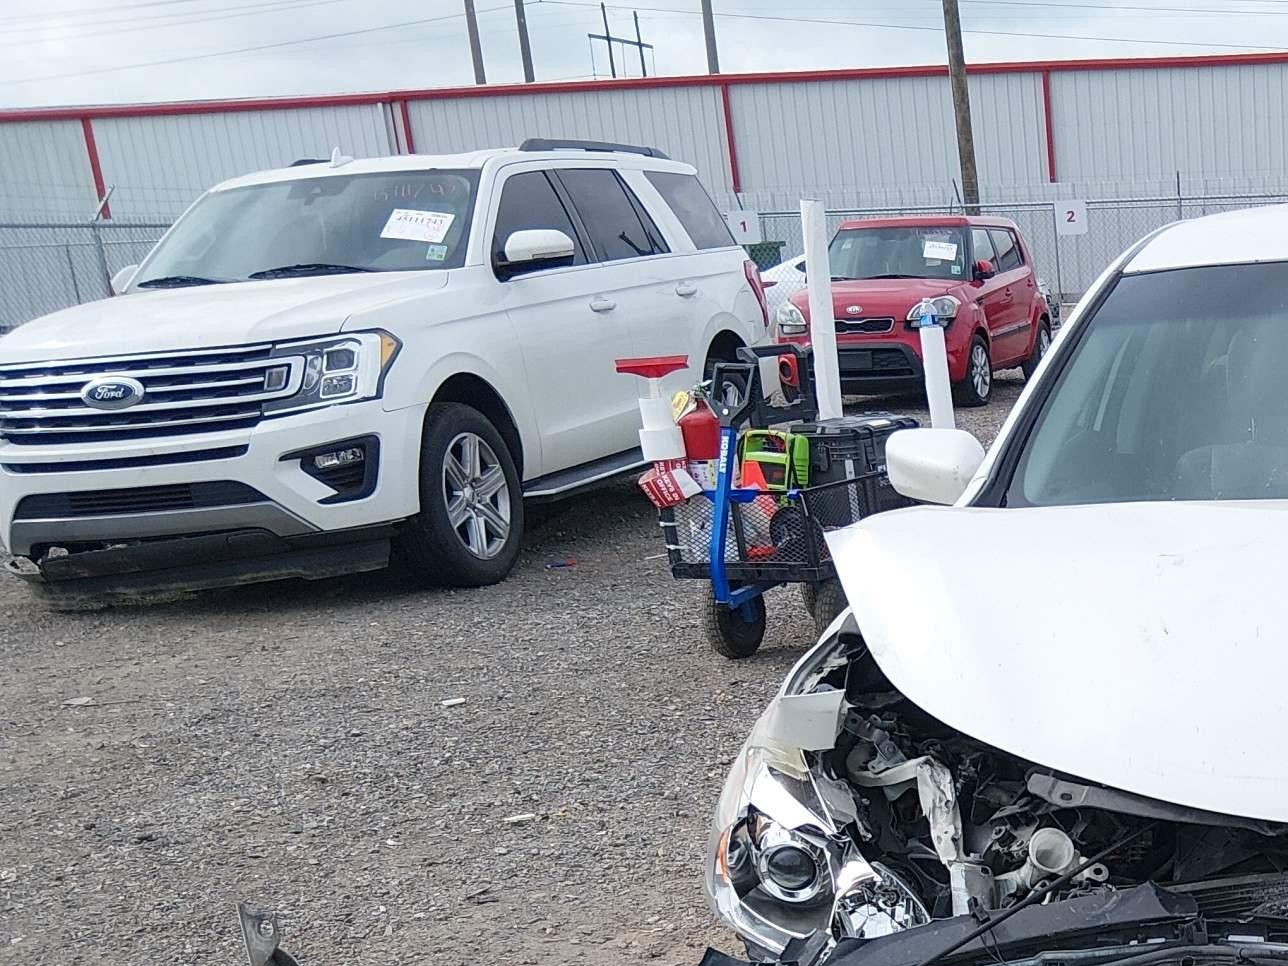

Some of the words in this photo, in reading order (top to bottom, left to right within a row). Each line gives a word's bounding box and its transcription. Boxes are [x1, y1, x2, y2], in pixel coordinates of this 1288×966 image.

[1066, 211, 1076, 223] 2
[740, 221, 747, 233] 1
[95, 385, 124, 400] Ford
[719, 436, 729, 473] KOBALT
[656, 479, 673, 501] OFFICE
[662, 474, 676, 493] KEYS
